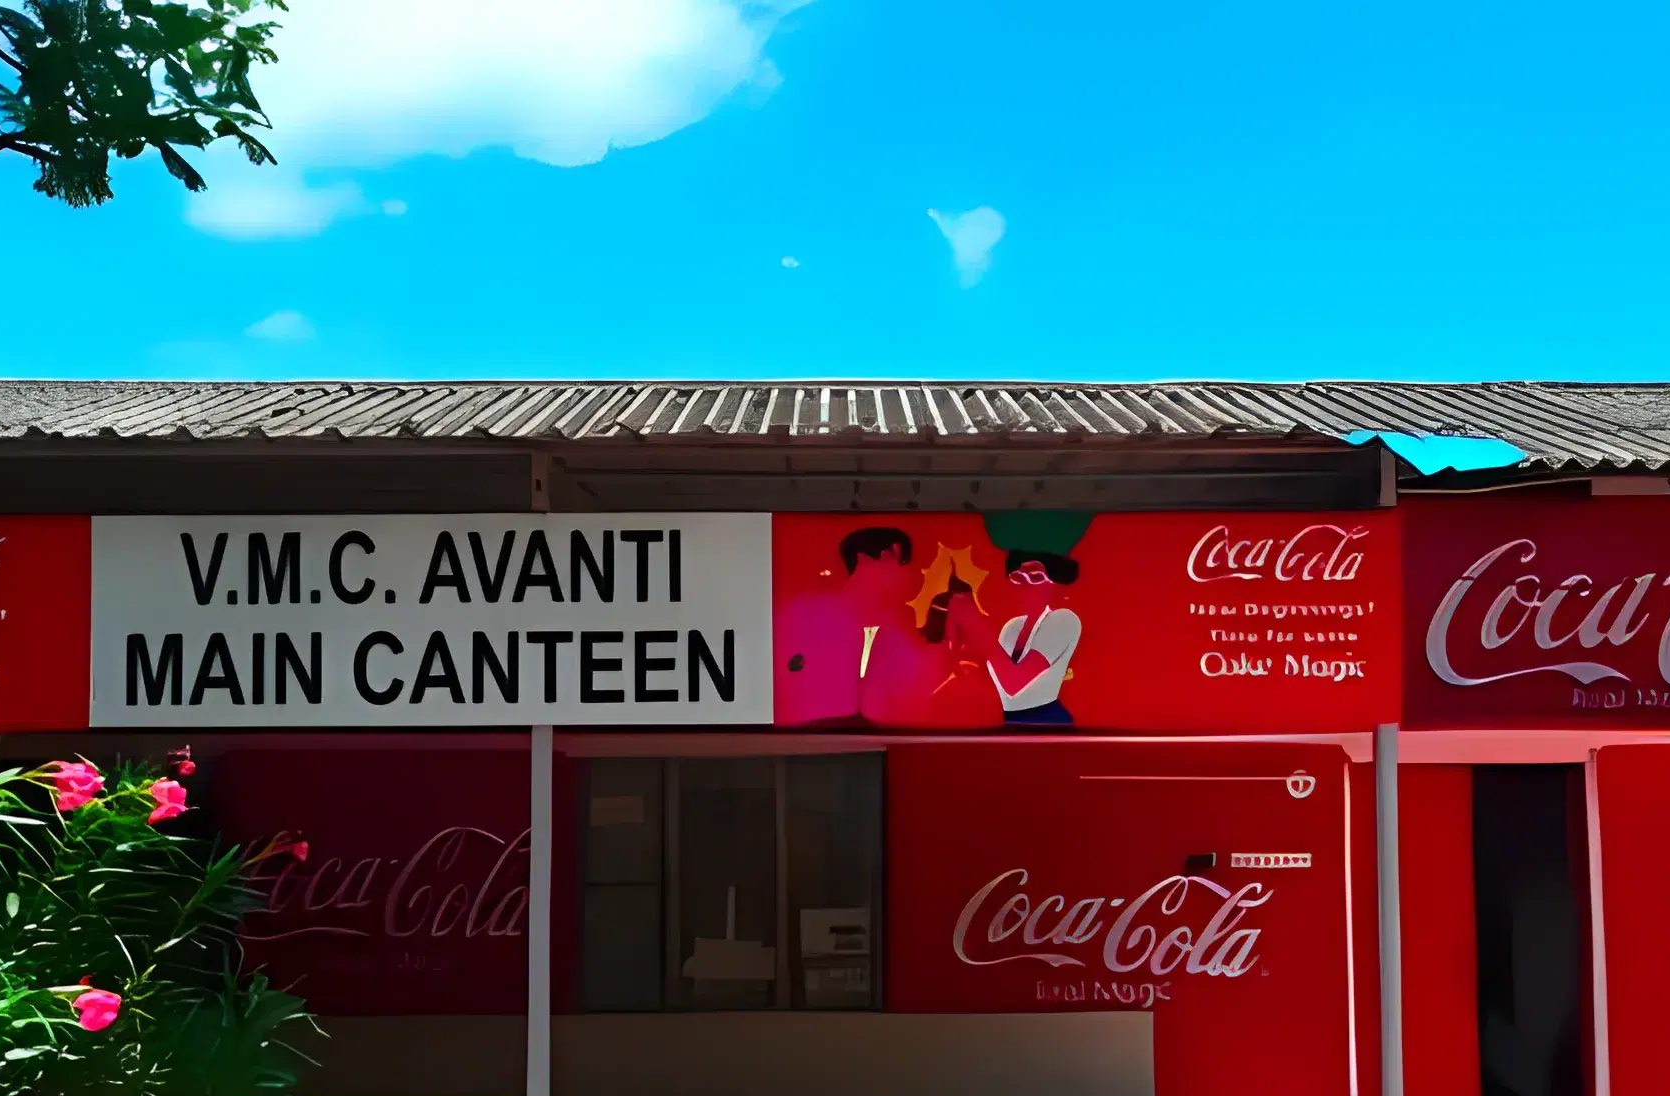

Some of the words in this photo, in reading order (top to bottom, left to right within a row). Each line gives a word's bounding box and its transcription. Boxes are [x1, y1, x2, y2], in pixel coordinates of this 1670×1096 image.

[180, 529, 397, 606] V.M.C.
[419, 528, 682, 604] AVANTI
[1186, 524, 1370, 582] Coca-Cola
[126, 631, 322, 707] MAIN
[353, 628, 735, 706] CANTEEN
[952, 868, 1274, 978] Coca-Cola
